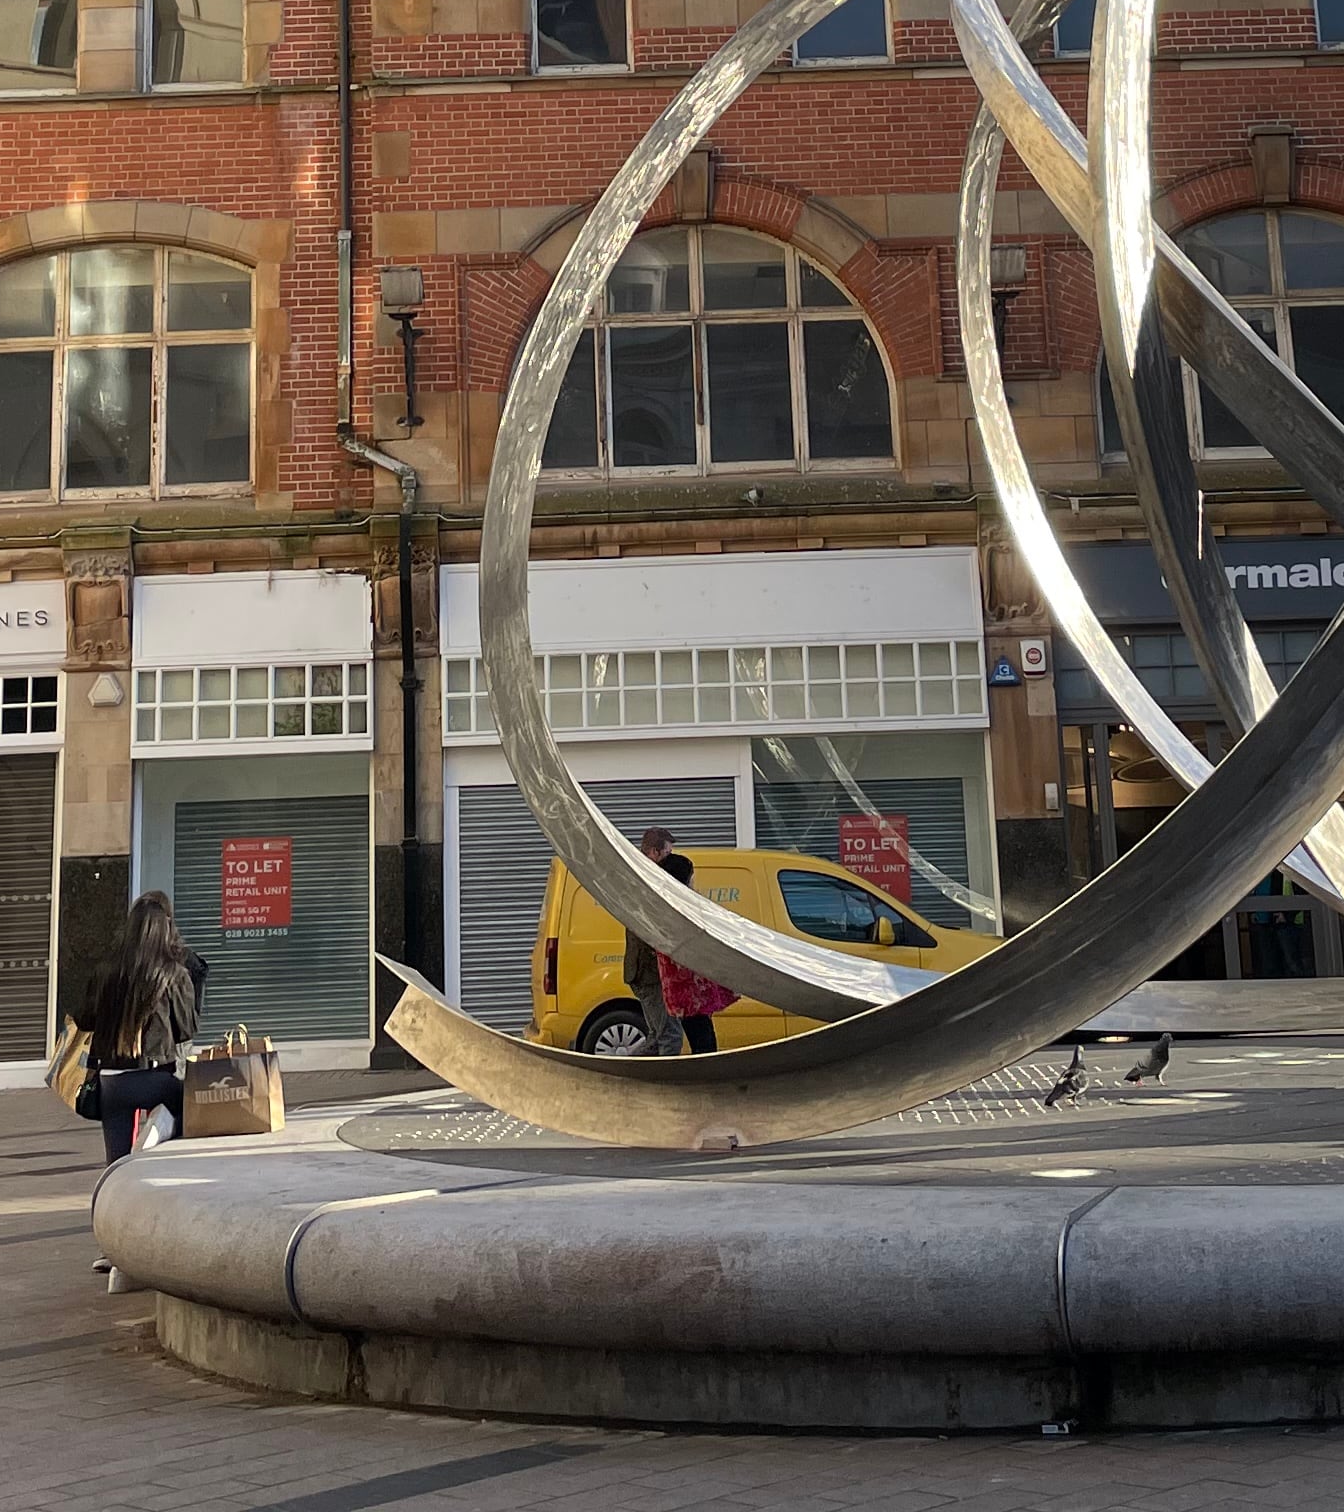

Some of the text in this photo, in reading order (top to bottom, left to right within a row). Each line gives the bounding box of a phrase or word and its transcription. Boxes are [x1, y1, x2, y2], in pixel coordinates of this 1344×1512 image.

[843, 837, 899, 851] TO LET
[844, 854, 875, 863] PRIME
[225, 859, 284, 874] TO LET
[882, 864, 906, 873] UNIT
[225, 876, 257, 886] PRIME
[225, 886, 288, 897] RETAIL UNIT
[247, 906, 259, 914] SQ
[260, 906, 271, 914] FT
[225, 930, 242, 938] 028
[243, 929, 266, 938] 9023
[194, 1087, 250, 1105] HOLLISTER
